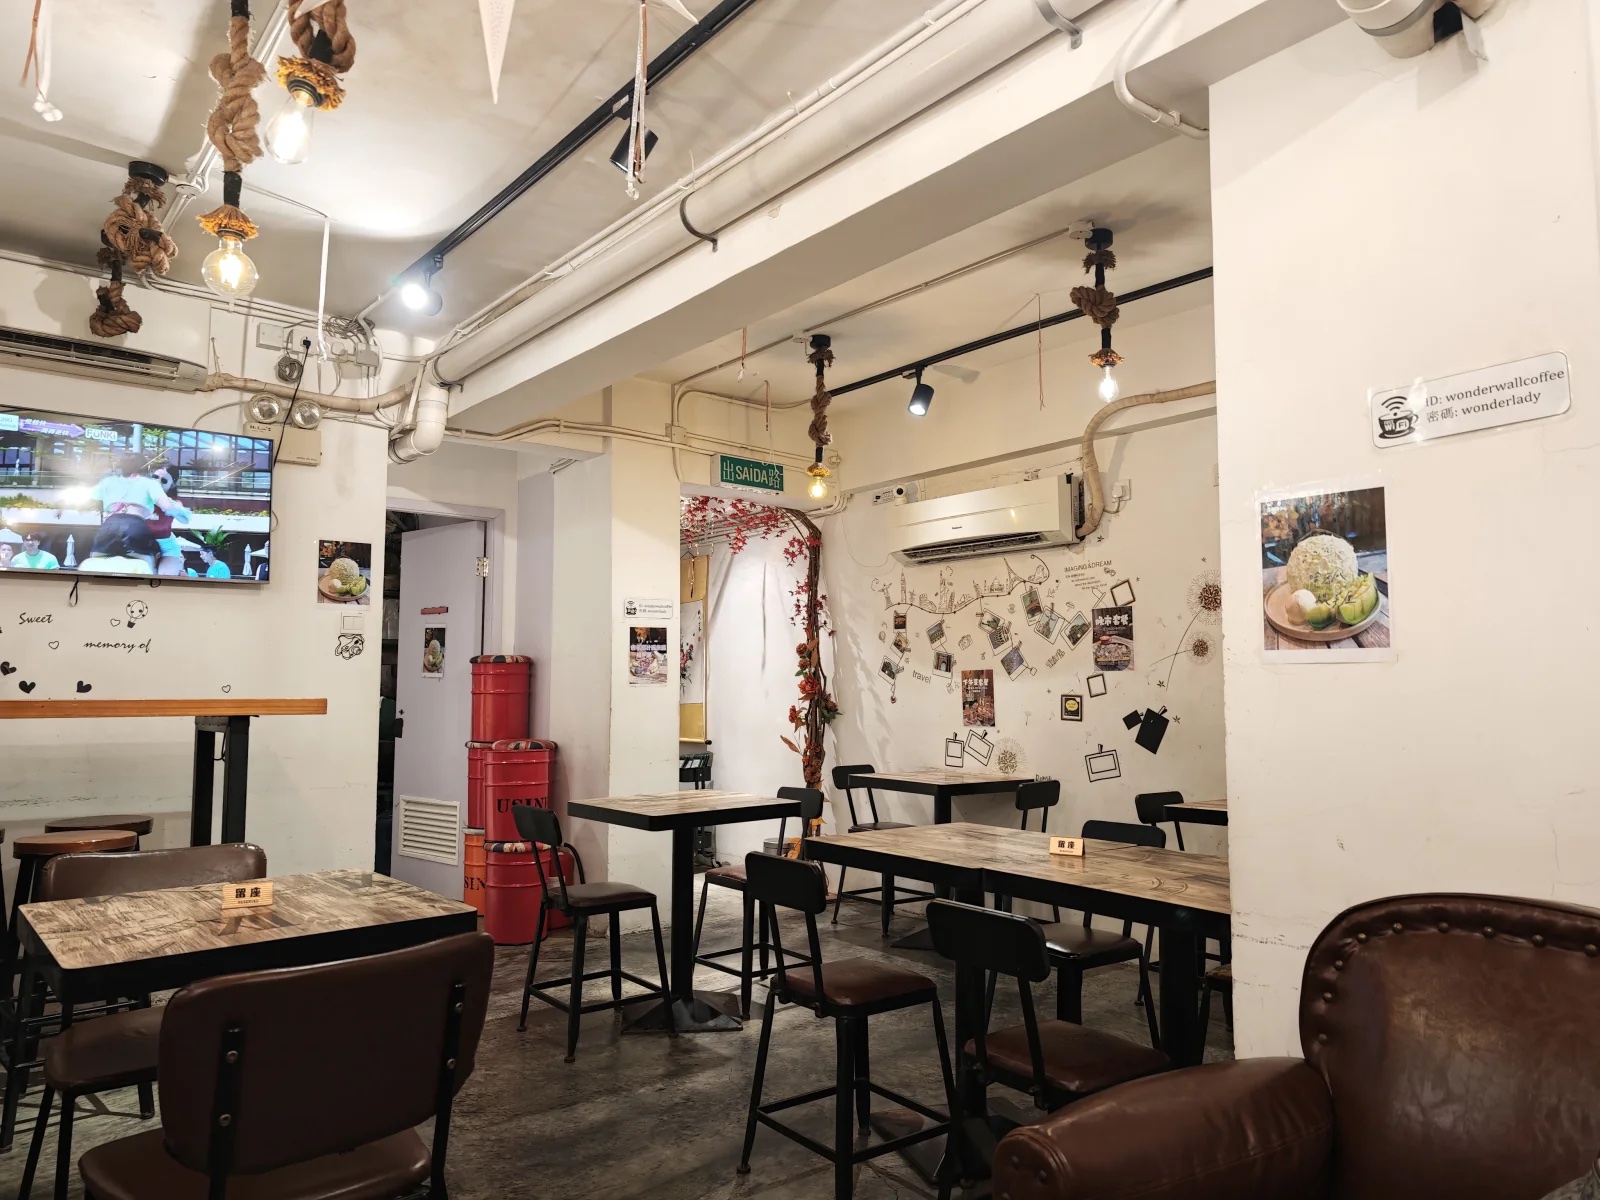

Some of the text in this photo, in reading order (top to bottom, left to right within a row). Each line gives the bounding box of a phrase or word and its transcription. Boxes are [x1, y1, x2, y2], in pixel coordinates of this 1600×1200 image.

[1445, 370, 1565, 402] wonderwallcoffee
[1461, 391, 1542, 415] wonderlady
[19, 612, 53, 625] Sweet
[83, 639, 152, 654] memory of
[912, 669, 932, 685] travel
